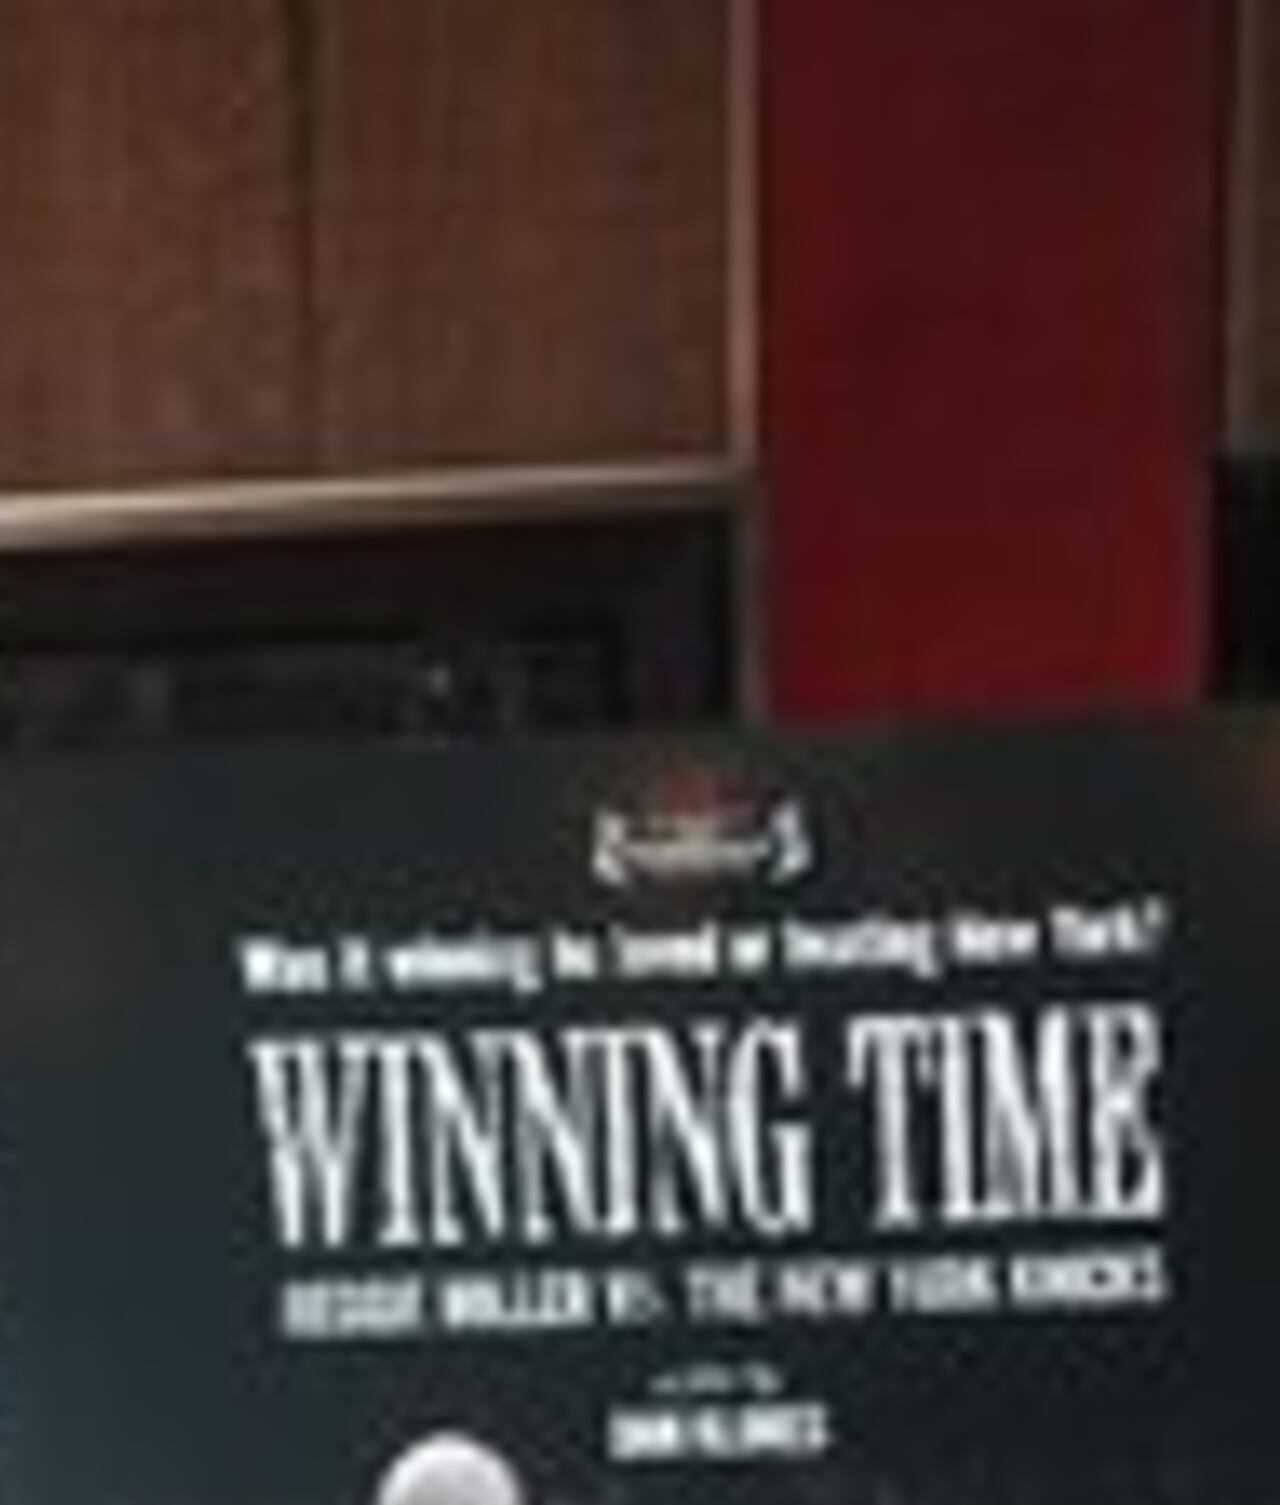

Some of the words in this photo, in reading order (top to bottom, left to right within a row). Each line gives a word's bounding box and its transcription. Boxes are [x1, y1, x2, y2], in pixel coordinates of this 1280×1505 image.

[948, 908, 1040, 964] New
[246, 1016, 814, 1250] WINNING
[847, 1002, 1164, 1232] TIME
[441, 1262, 596, 1333] MILLER
[685, 1256, 763, 1326] THE
[776, 1256, 872, 1320] NEW
[1007, 1242, 1168, 1310] KNICKS
